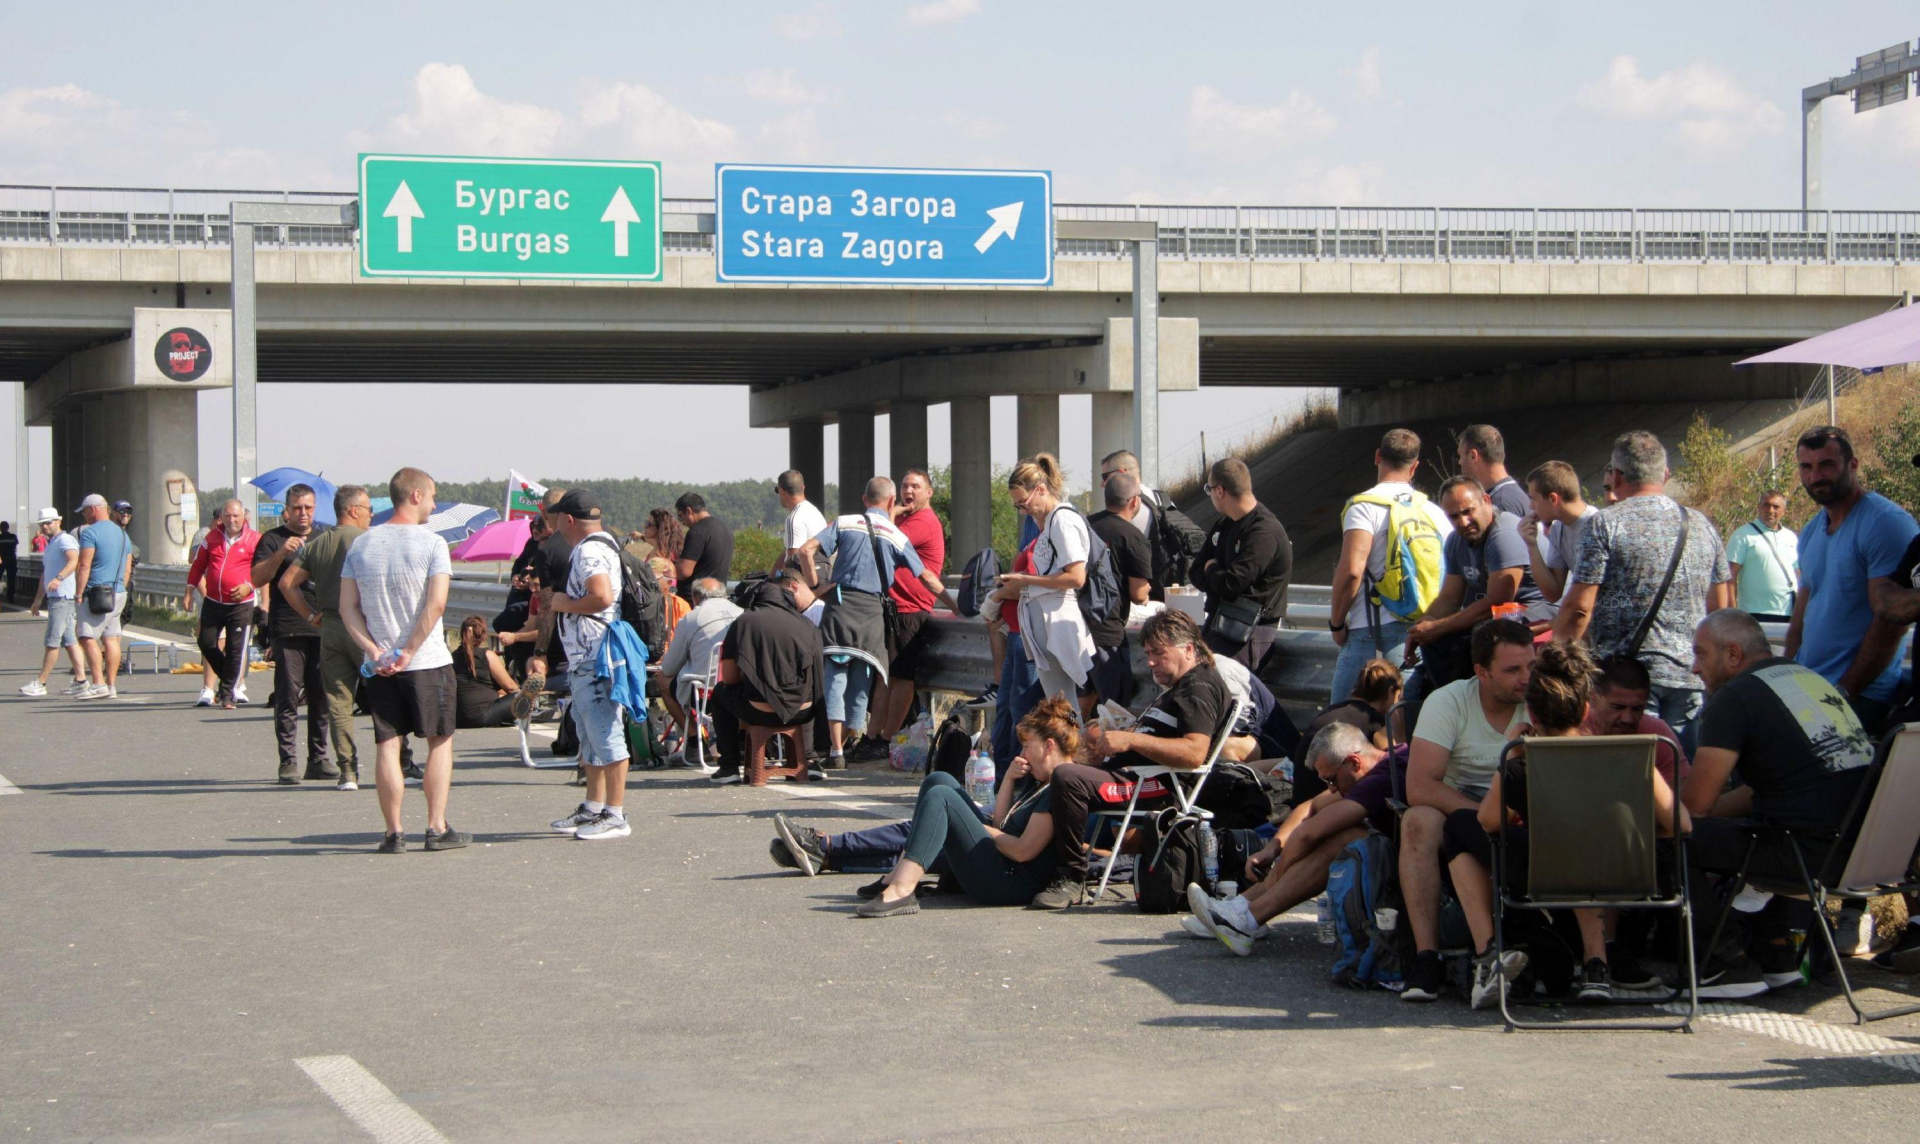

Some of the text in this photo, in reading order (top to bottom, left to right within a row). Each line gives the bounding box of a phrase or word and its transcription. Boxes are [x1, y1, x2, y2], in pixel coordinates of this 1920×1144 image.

[455, 180, 570, 216] Бургас
[742, 186, 956, 224] Стара Загора
[457, 224, 570, 261] Burgas
[742, 229, 944, 267] Stara Zagora
[169, 351, 199, 361] PROJECT
